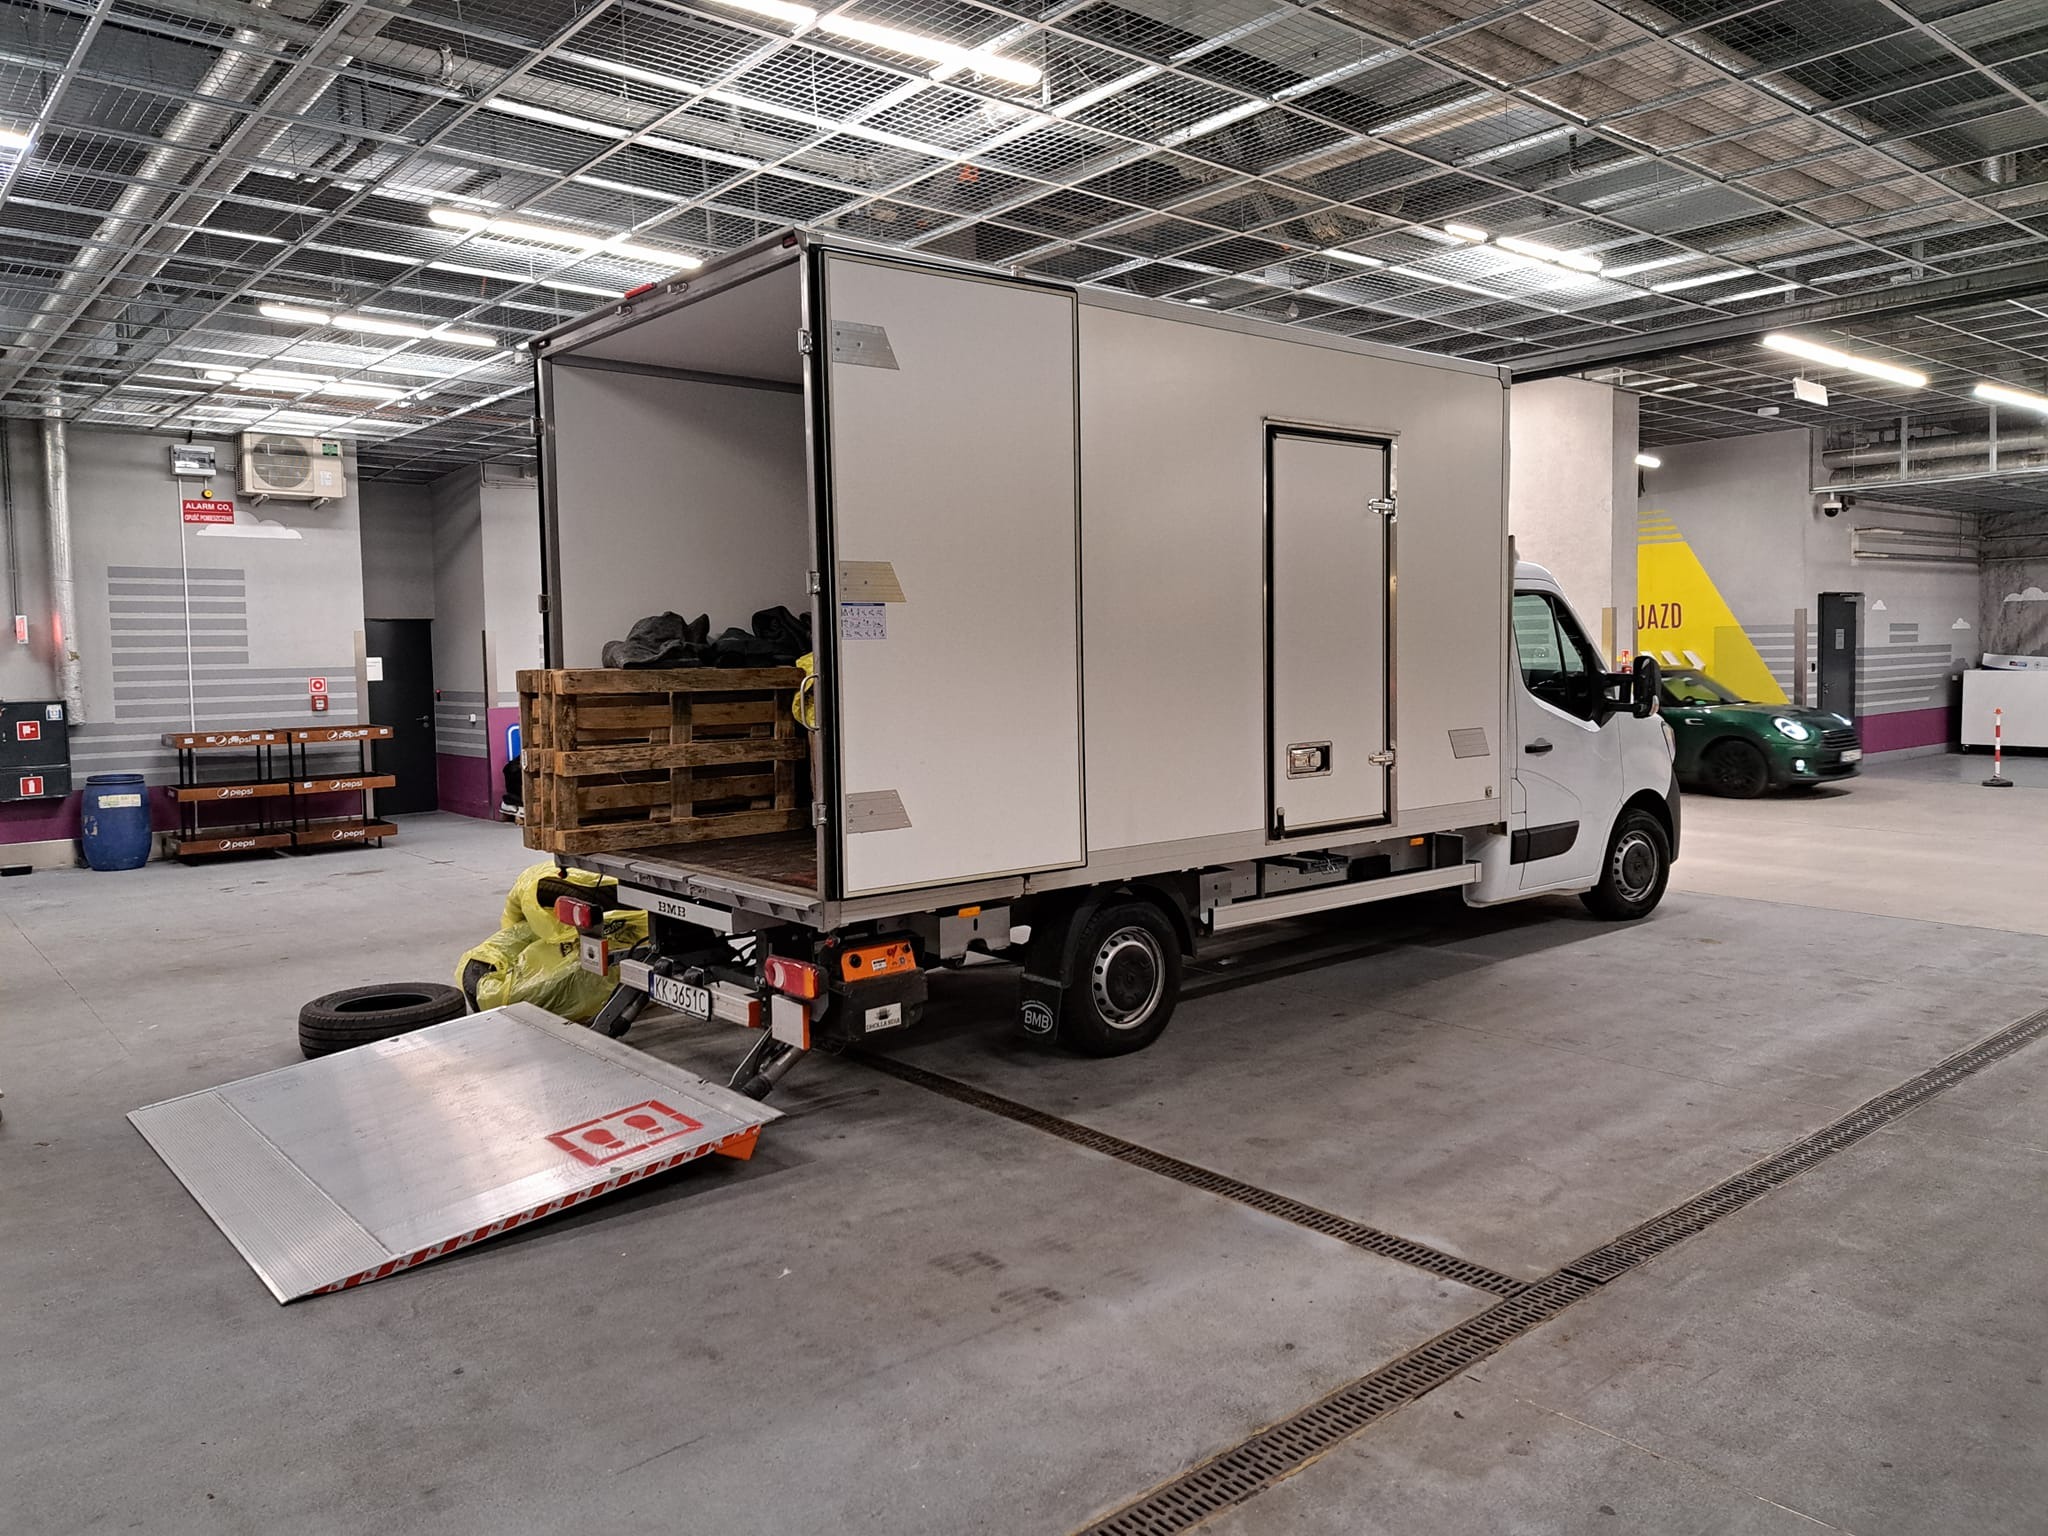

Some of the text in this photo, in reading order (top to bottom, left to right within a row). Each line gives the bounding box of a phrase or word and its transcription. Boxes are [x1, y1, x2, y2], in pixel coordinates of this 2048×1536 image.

[185, 502, 215, 511] ALARM
[228, 735, 251, 745] ppsi
[341, 780, 363, 790] pepsi
[230, 787, 254, 797] pepsi
[343, 829, 366, 839] pepsi
[232, 839, 256, 849] pepsi
[658, 901, 686, 918] BMB
[655, 976, 706, 1014] KK 3651C
[1024, 1010, 1050, 1029] BMB
